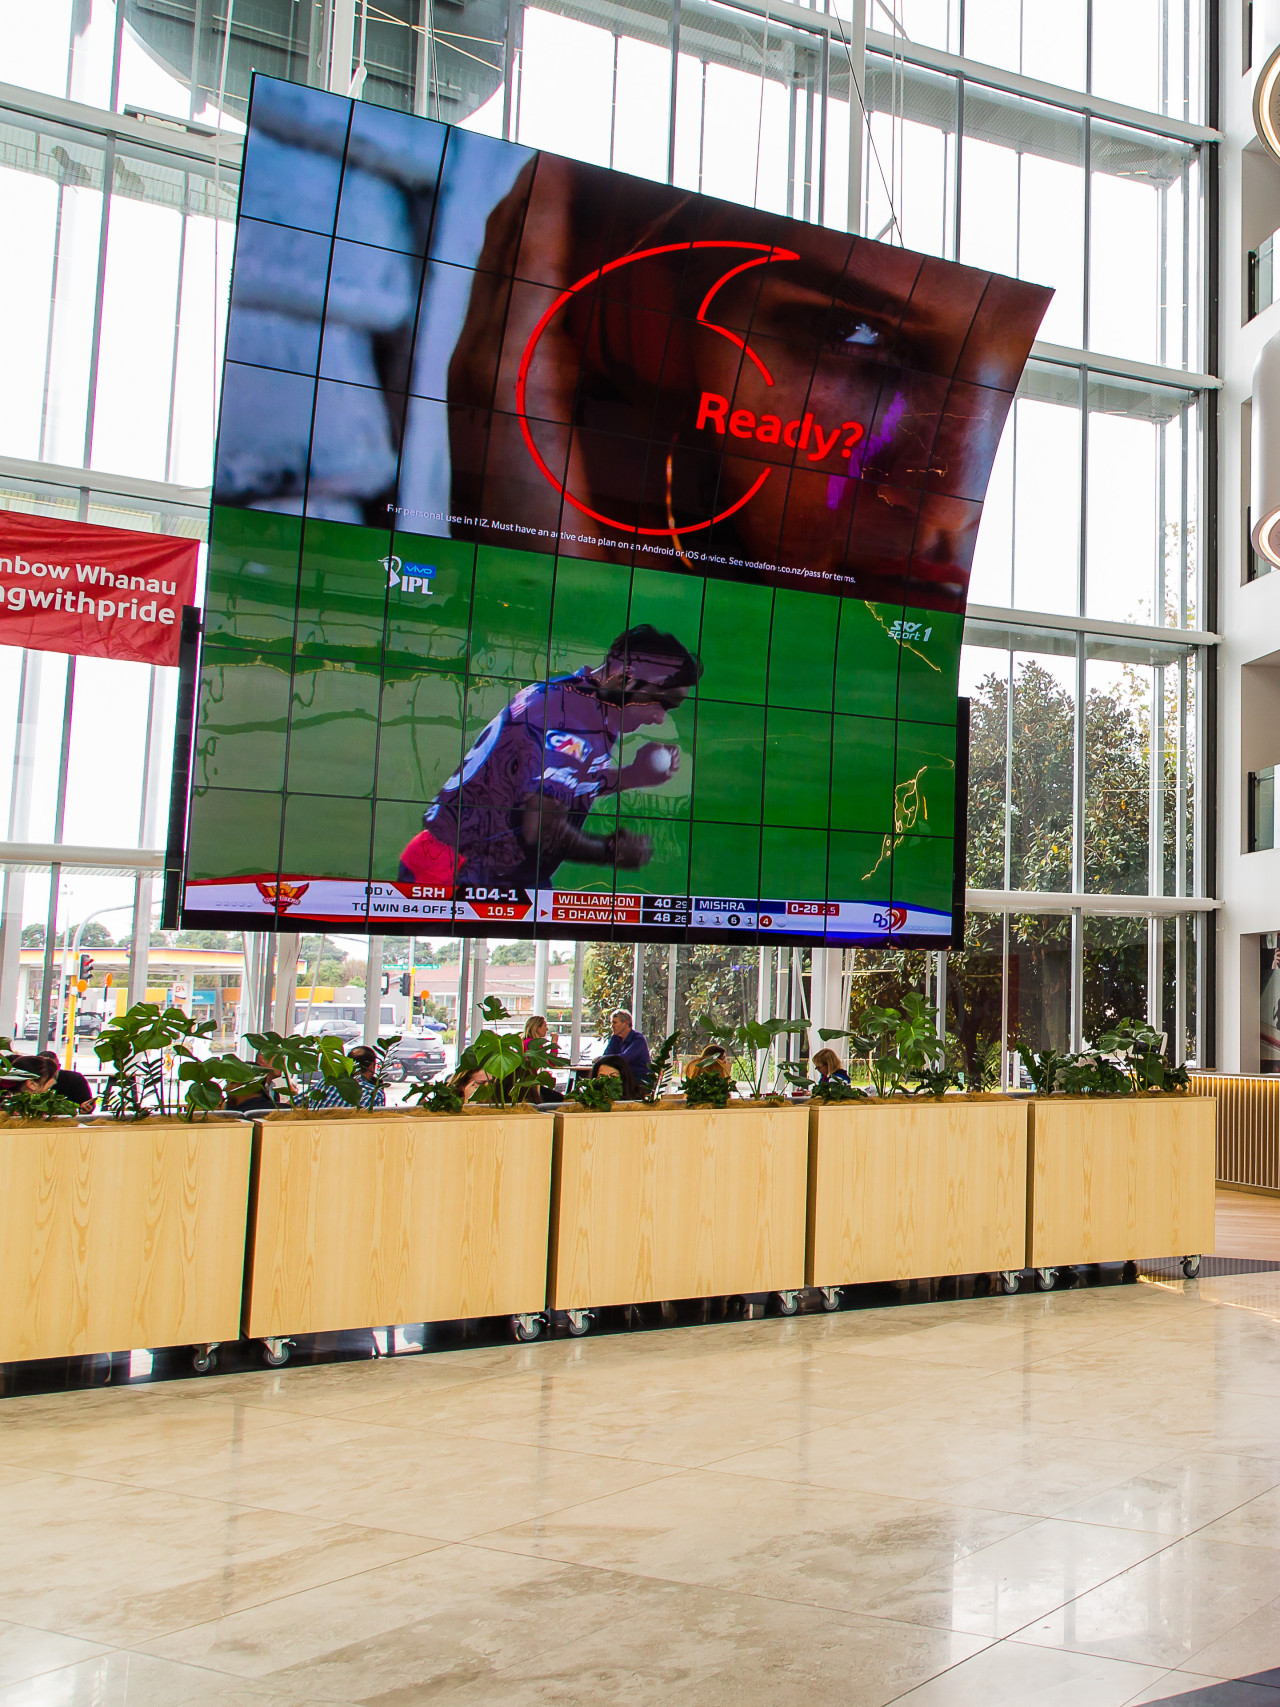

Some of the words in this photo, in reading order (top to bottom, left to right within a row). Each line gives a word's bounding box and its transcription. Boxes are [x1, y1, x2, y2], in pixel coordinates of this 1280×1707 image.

[695, 392, 864, 461] Ready?
[403, 508, 444, 521] personal
[446, 514, 462, 523] use
[464, 516, 473, 525] in
[491, 520, 514, 531] Must
[515, 523, 537, 535] have
[538, 529, 549, 537] an
[577, 534, 597, 544] data
[597, 537, 617, 547] plan
[617, 541, 629, 549] on
[642, 544, 675, 556] Android
[685, 550, 699, 560] iOS
[728, 557, 744, 567] See
[821, 570, 833, 580] for
[833, 573, 857, 584] terms.
[0, 555, 71, 580] nbow
[75, 563, 177, 596] Whanau
[406, 565, 433, 575] vivo
[401, 575, 434, 595] IPL
[923, 627, 933, 642] 1
[411, 886, 446, 898] SRH
[465, 887, 519, 901] 104-1
[558, 894, 635, 907] WILLIAMSON
[653, 898, 672, 909] 40
[699, 900, 746, 911] MISHRA
[373, 903, 400, 912] WIN
[402, 905, 419, 914] 84
[422, 905, 448, 915] OFF
[486, 906, 515, 917] 10.5
[791, 903, 819, 914] 0-28
[557, 909, 566, 919] S
[568, 910, 627, 921] DHAWAN
[653, 912, 671, 922] 48
[674, 914, 687, 924] 26
